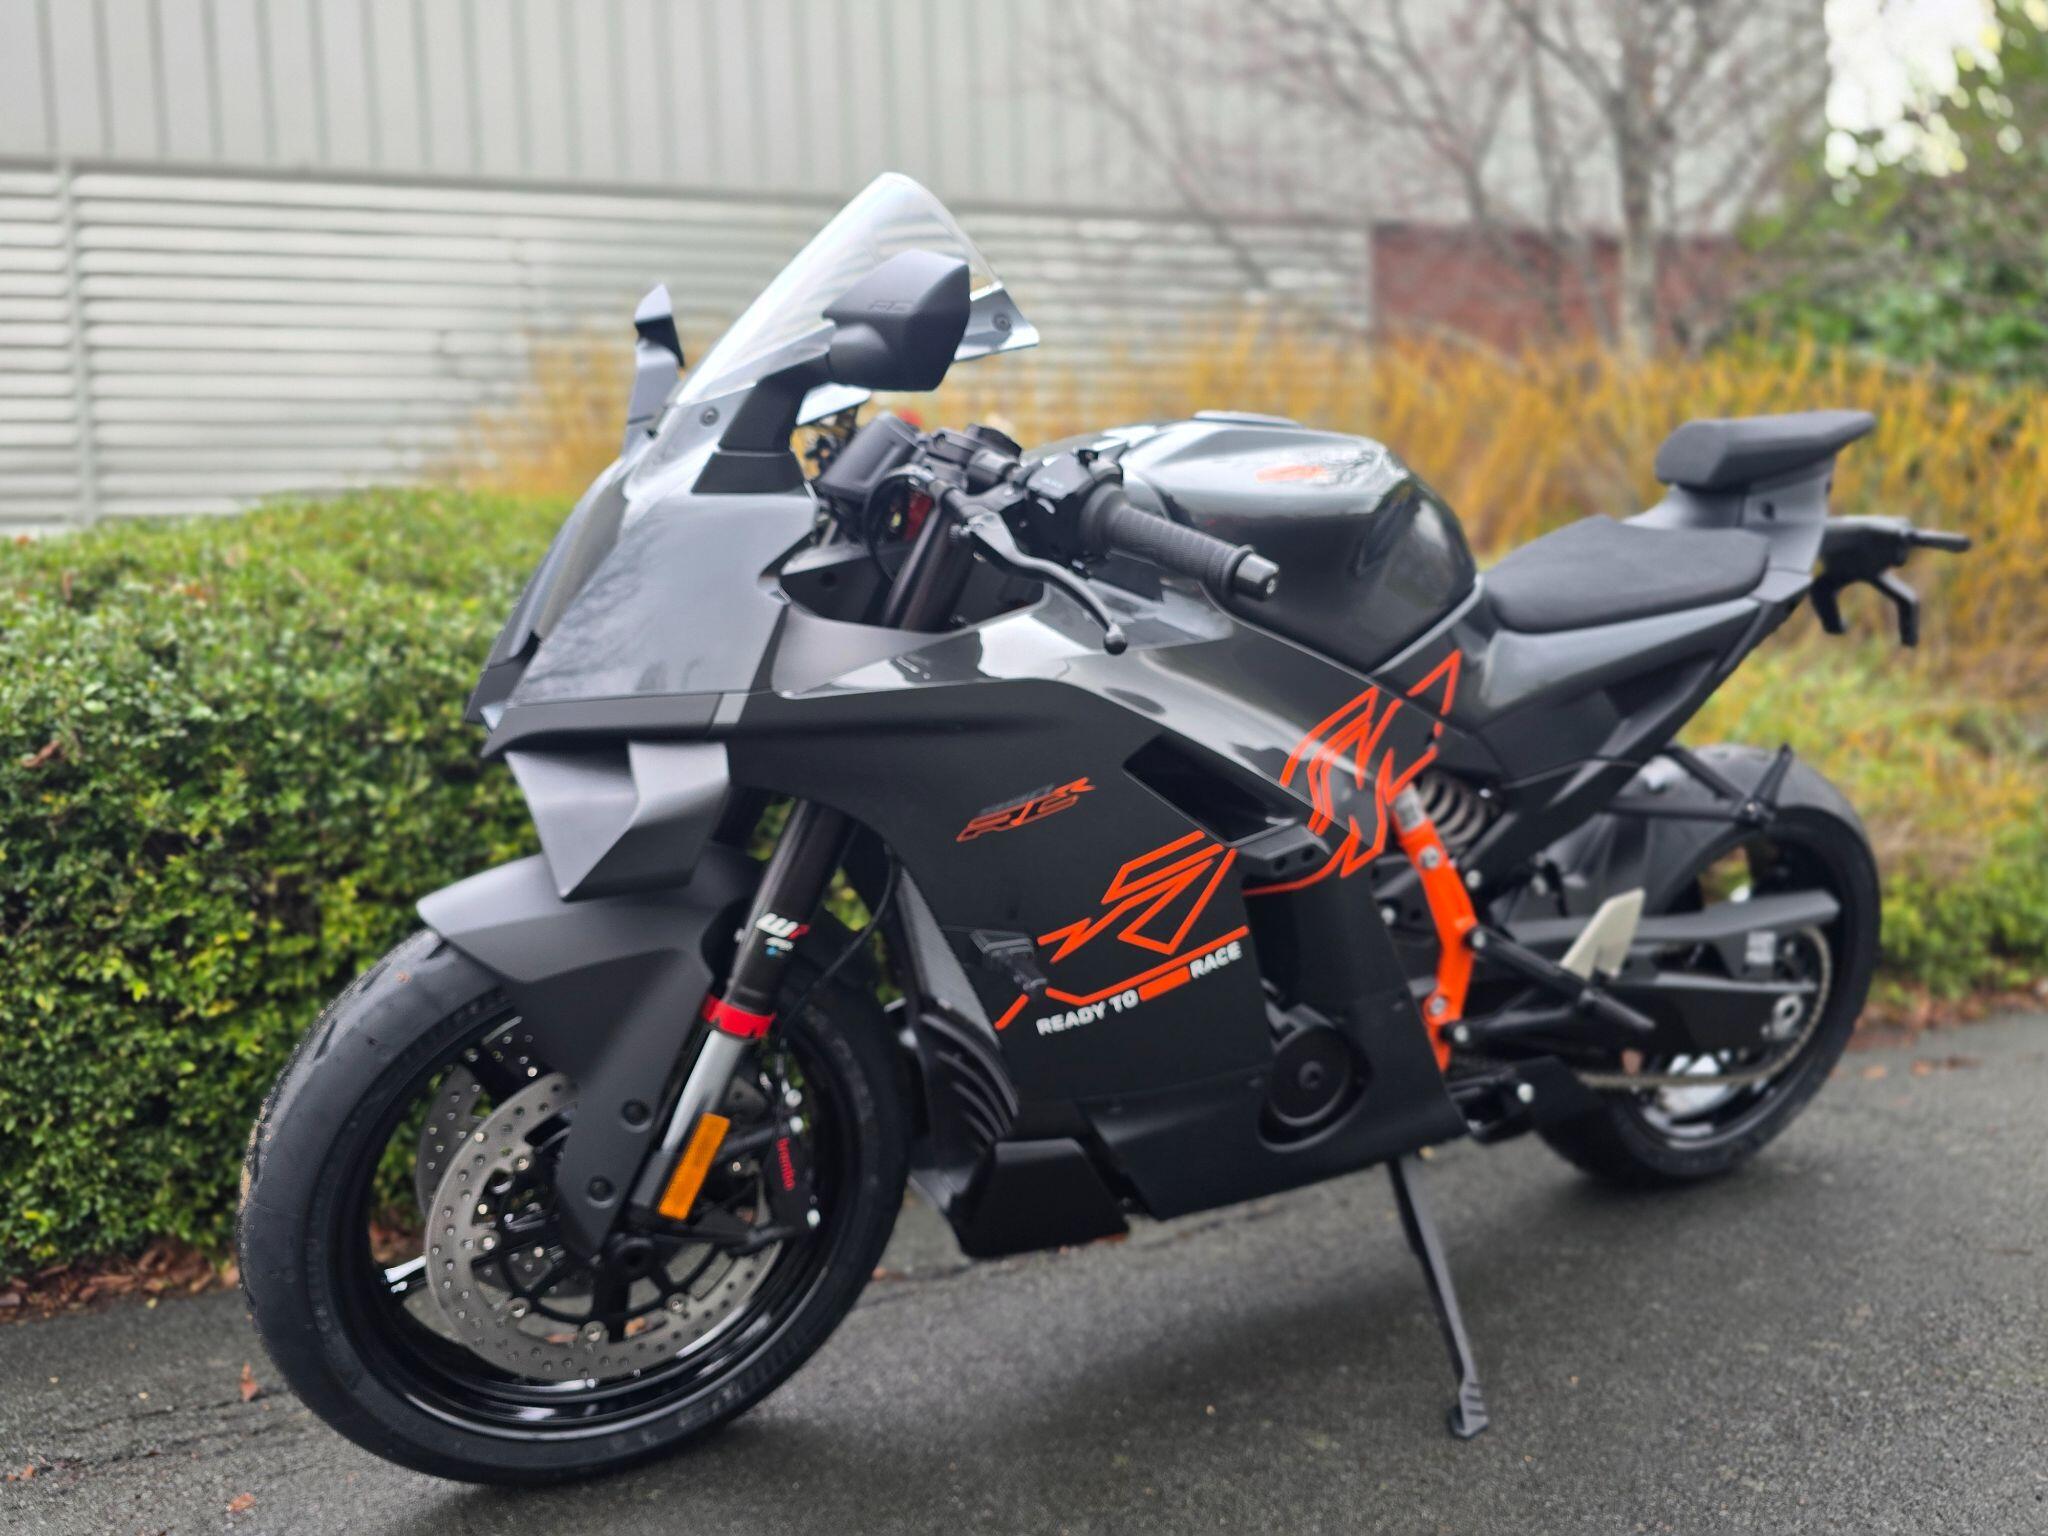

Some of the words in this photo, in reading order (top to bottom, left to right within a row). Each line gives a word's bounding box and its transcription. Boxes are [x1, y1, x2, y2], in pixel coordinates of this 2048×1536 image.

[1036, 1001, 1106, 1036] READY
[1108, 989, 1139, 1013] TO
[1190, 941, 1242, 978] RACE
